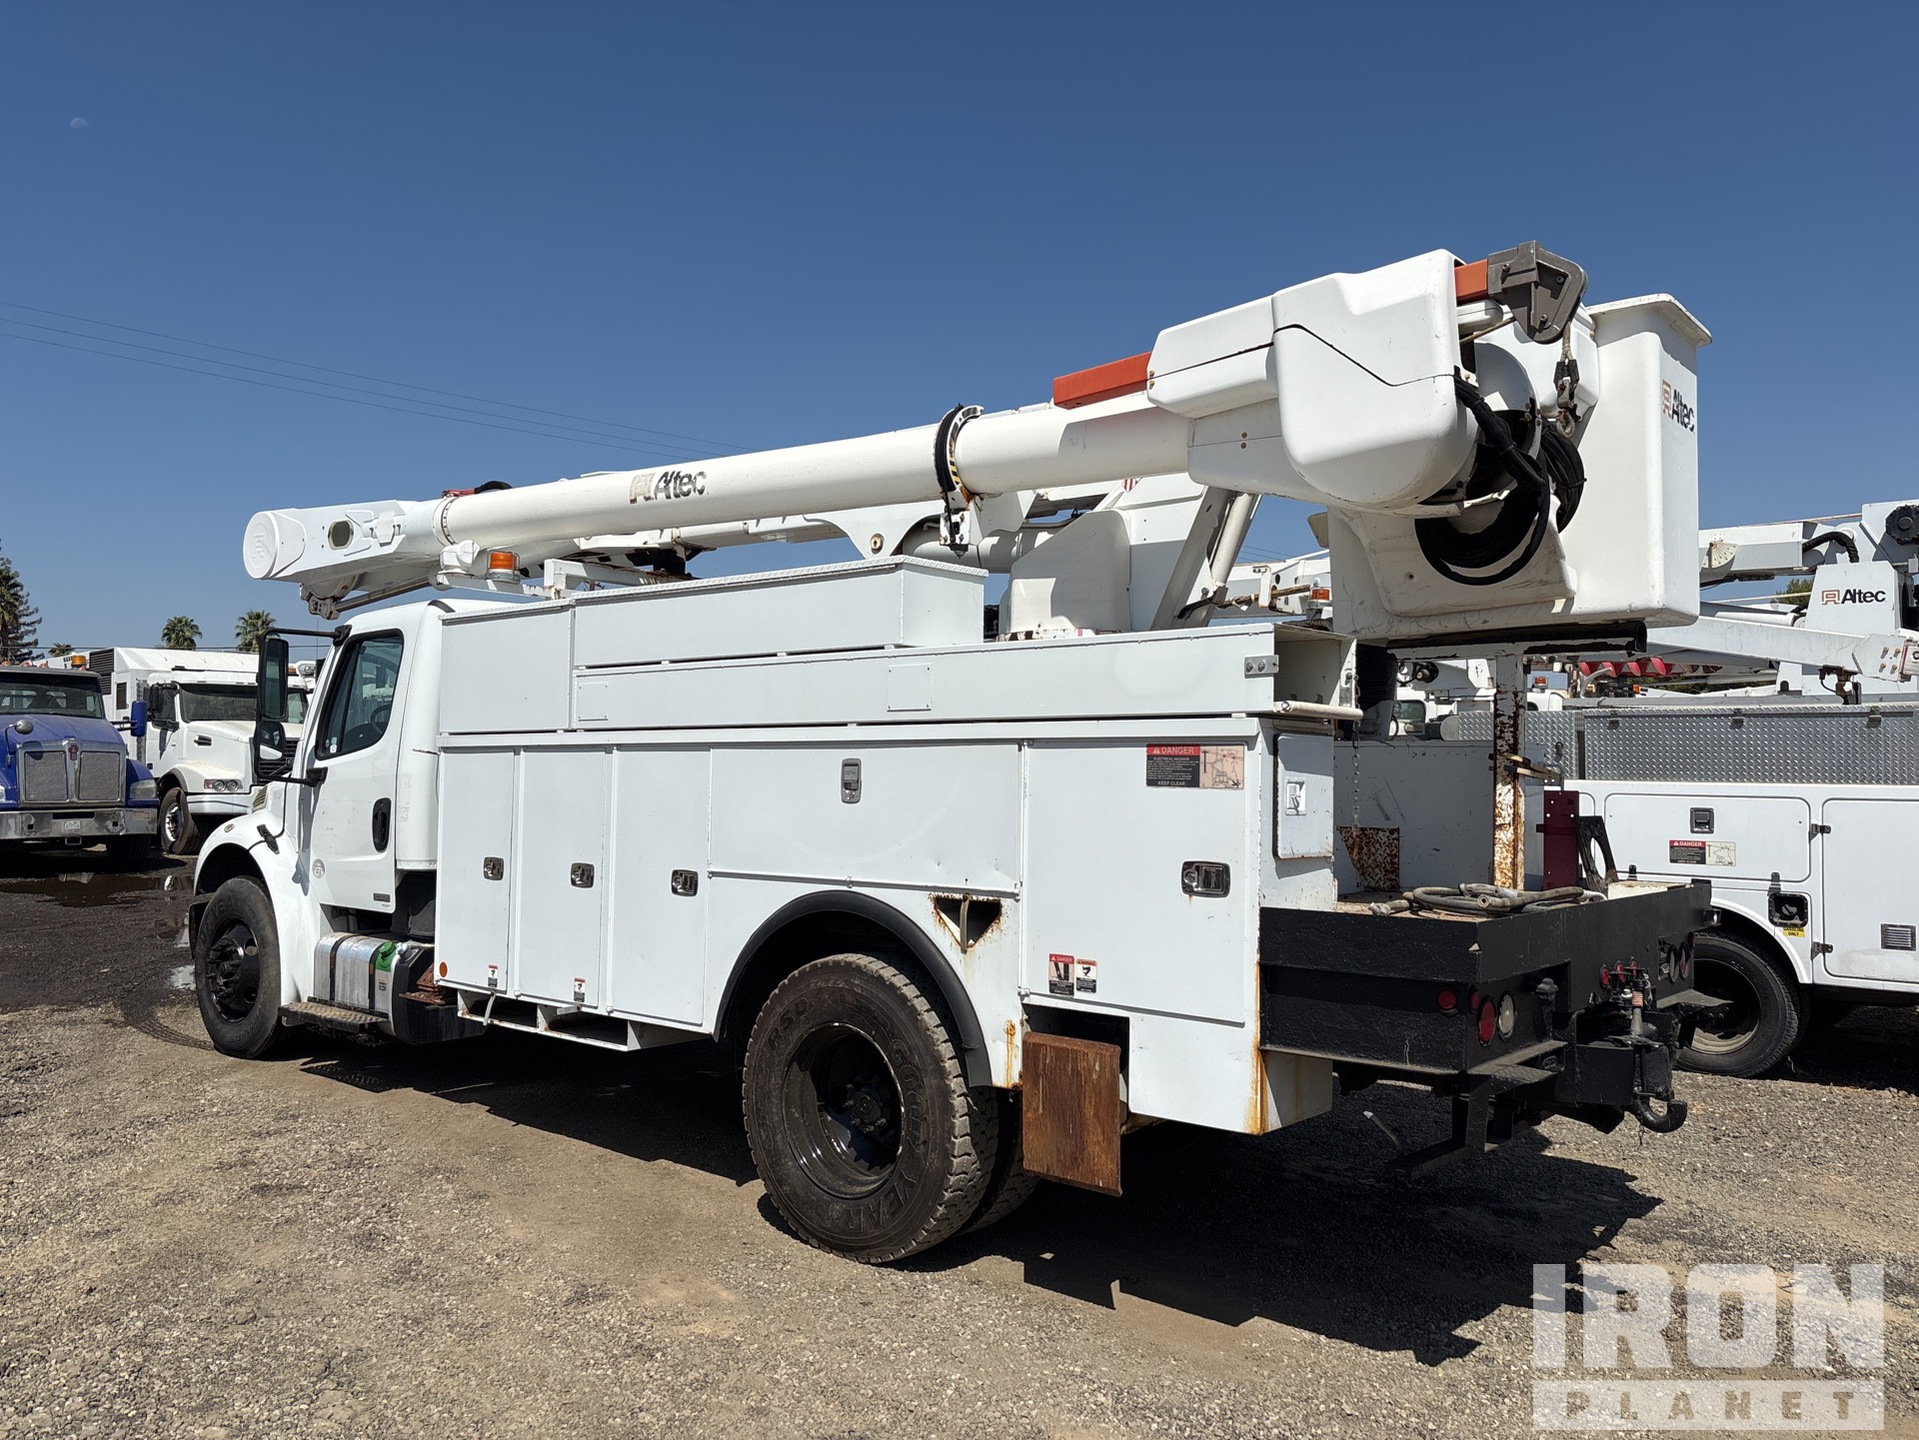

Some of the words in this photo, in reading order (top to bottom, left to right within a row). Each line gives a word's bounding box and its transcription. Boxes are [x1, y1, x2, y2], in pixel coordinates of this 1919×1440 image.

[1671, 388, 1695, 433] Altec
[653, 470, 707, 501] Altec
[1841, 588, 1886, 604] Altec
[1161, 746, 1194, 755] DANGER
[768, 997, 813, 1052] RSD
